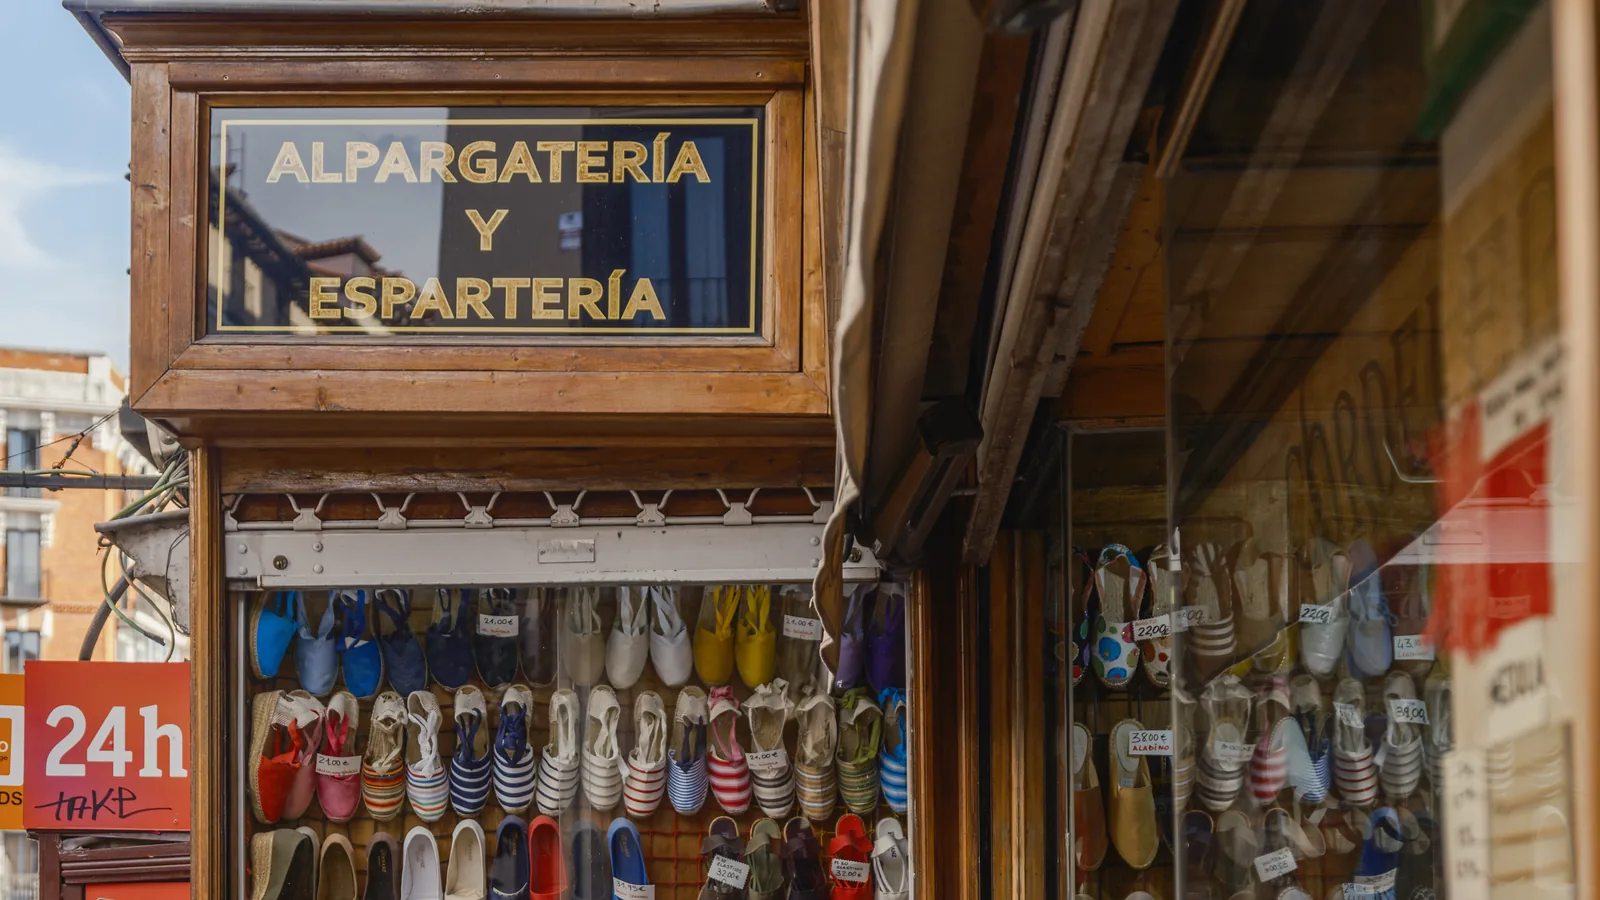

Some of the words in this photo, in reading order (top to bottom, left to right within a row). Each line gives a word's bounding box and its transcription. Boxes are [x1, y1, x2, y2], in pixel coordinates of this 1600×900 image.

[266, 132, 711, 184] ALPARGATERÍA
[465, 209, 509, 252] Y
[308, 269, 666, 320] ESPARTERÍA
[45, 704, 188, 778] 24h
